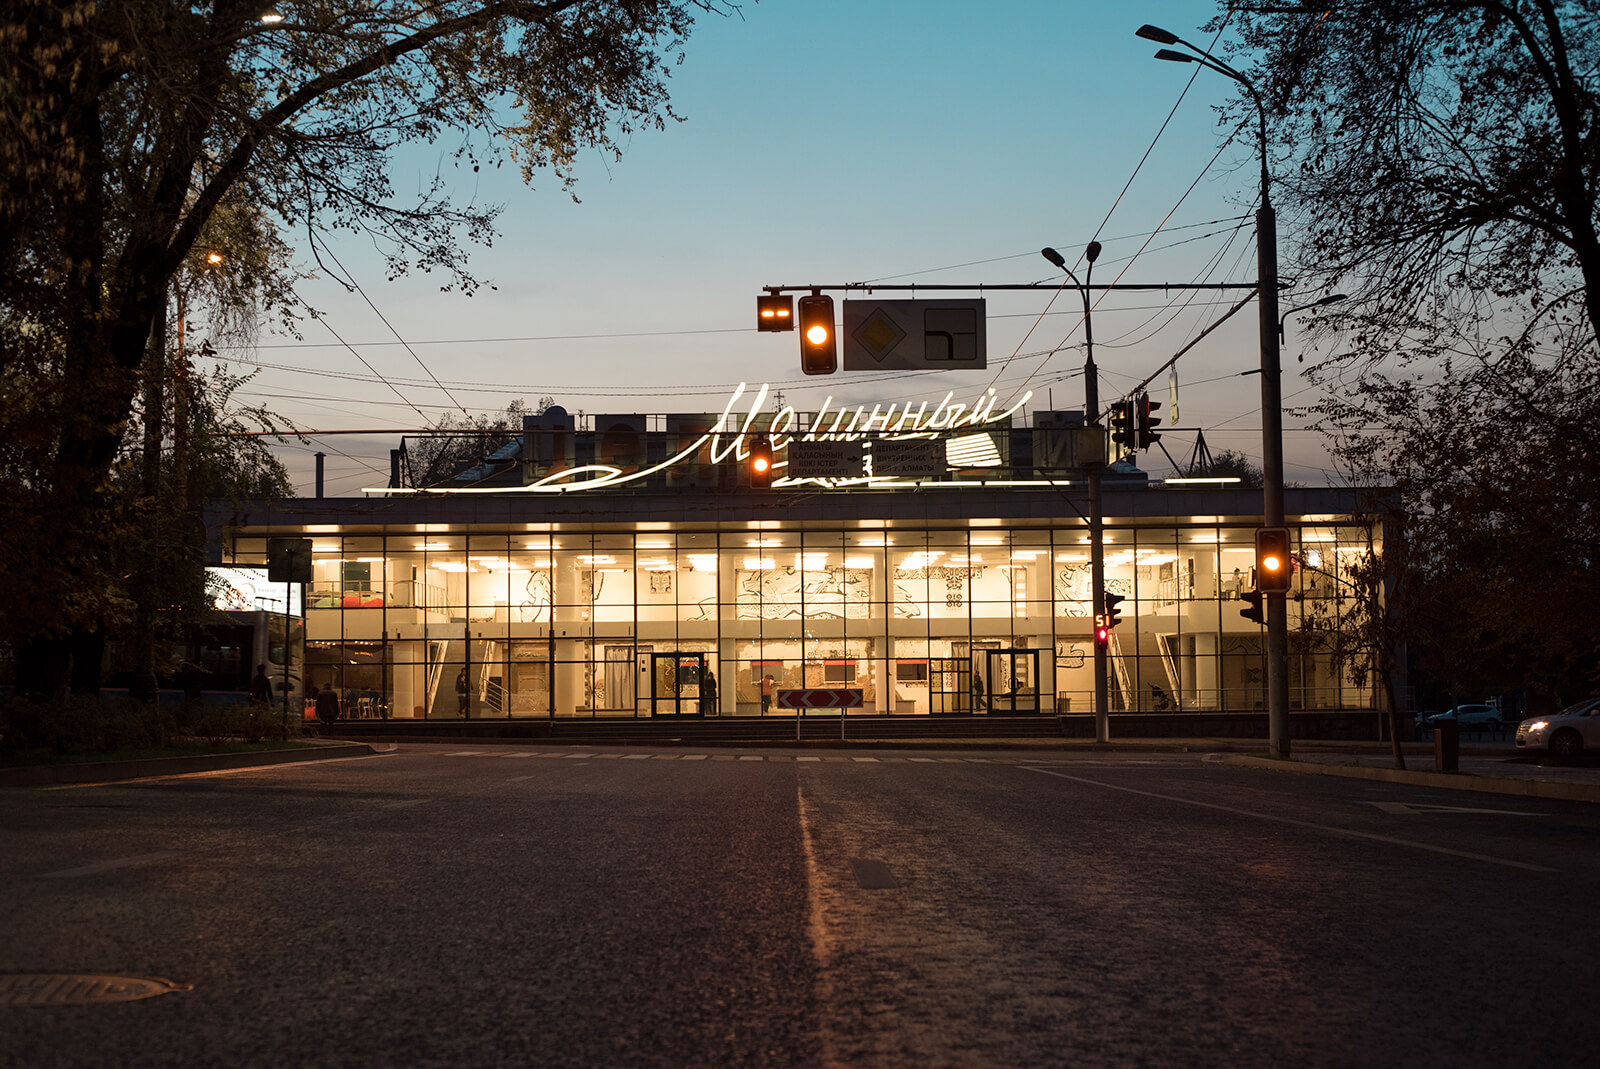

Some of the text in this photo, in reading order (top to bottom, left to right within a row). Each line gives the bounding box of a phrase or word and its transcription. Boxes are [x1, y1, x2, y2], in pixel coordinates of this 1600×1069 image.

[875, 444, 930, 452] ДЕПАРТАМЕНТ
[902, 464, 935, 472] АЛМАТЫ
[1095, 614, 1110, 627] 51
